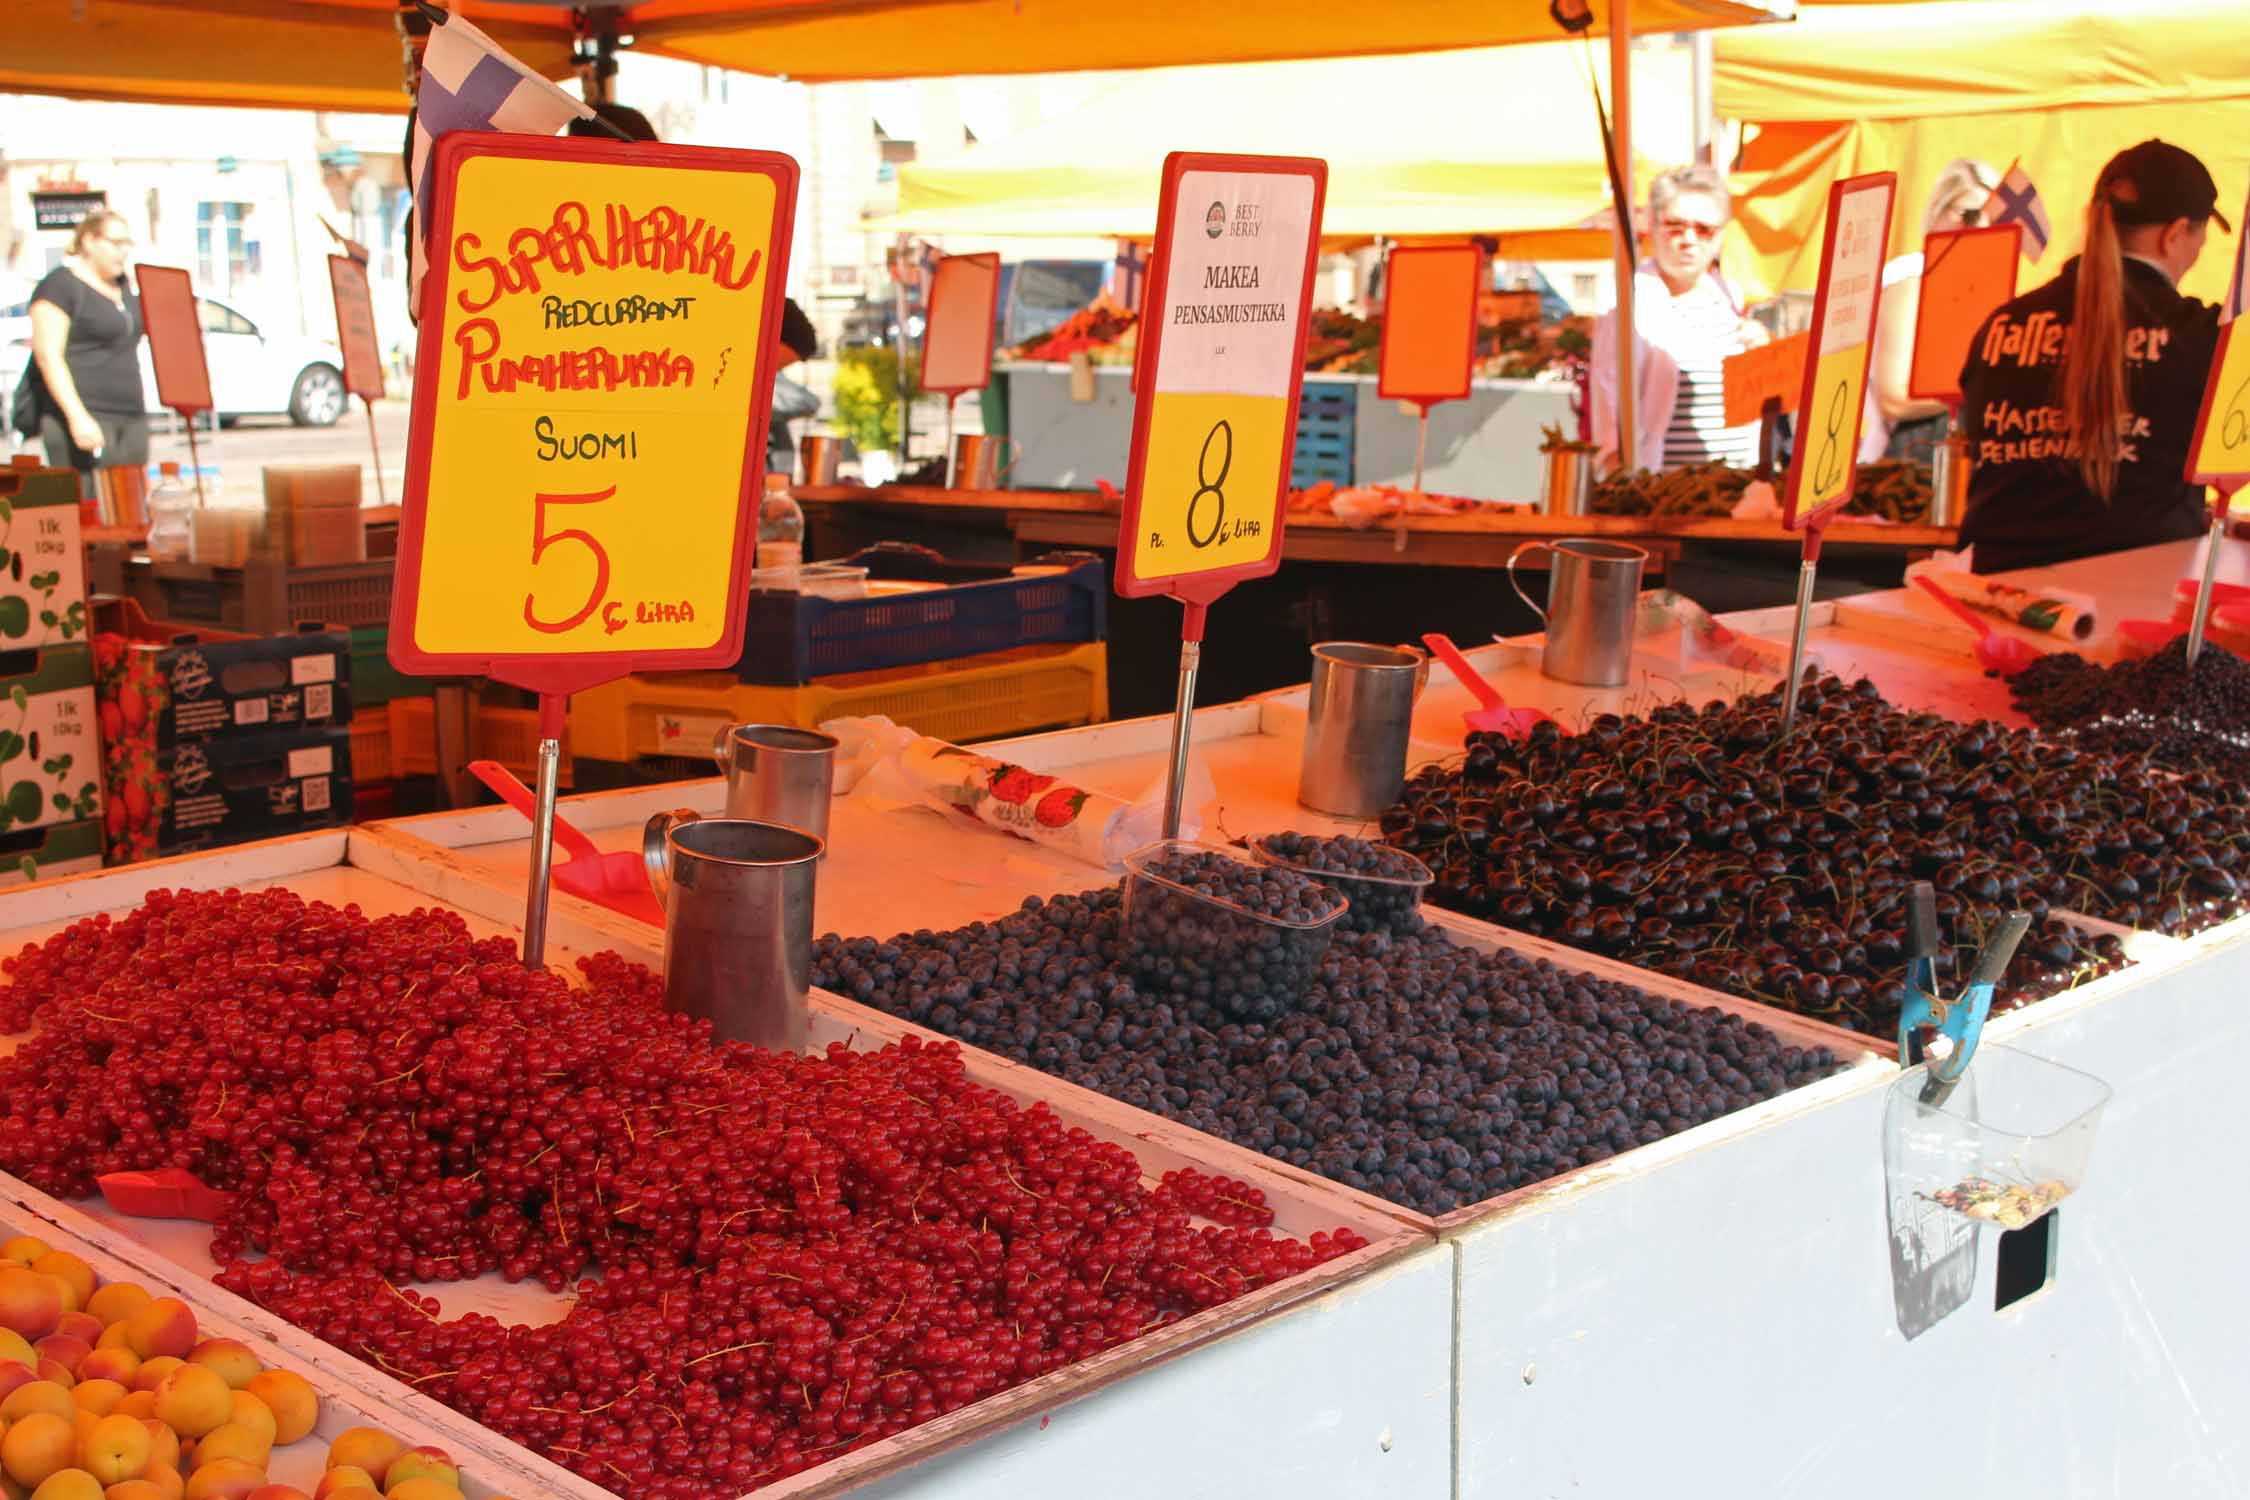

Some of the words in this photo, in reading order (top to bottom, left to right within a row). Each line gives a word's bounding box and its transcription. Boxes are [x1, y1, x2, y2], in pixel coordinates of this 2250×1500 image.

[1230, 221, 1262, 237] BERRY
[1235, 204, 1260, 219] BEST
[1203, 265, 1260, 289] MAKEA
[542, 295, 696, 330] REDCURRANT
[1173, 303, 1286, 325] PENSASMUSTIKKA
[455, 318, 696, 400] PUNAHERUKKA
[535, 415, 638, 461] SUOMI
[1814, 379, 1848, 496] 8
[1186, 419, 1233, 549] 8
[523, 484, 617, 634] 5
